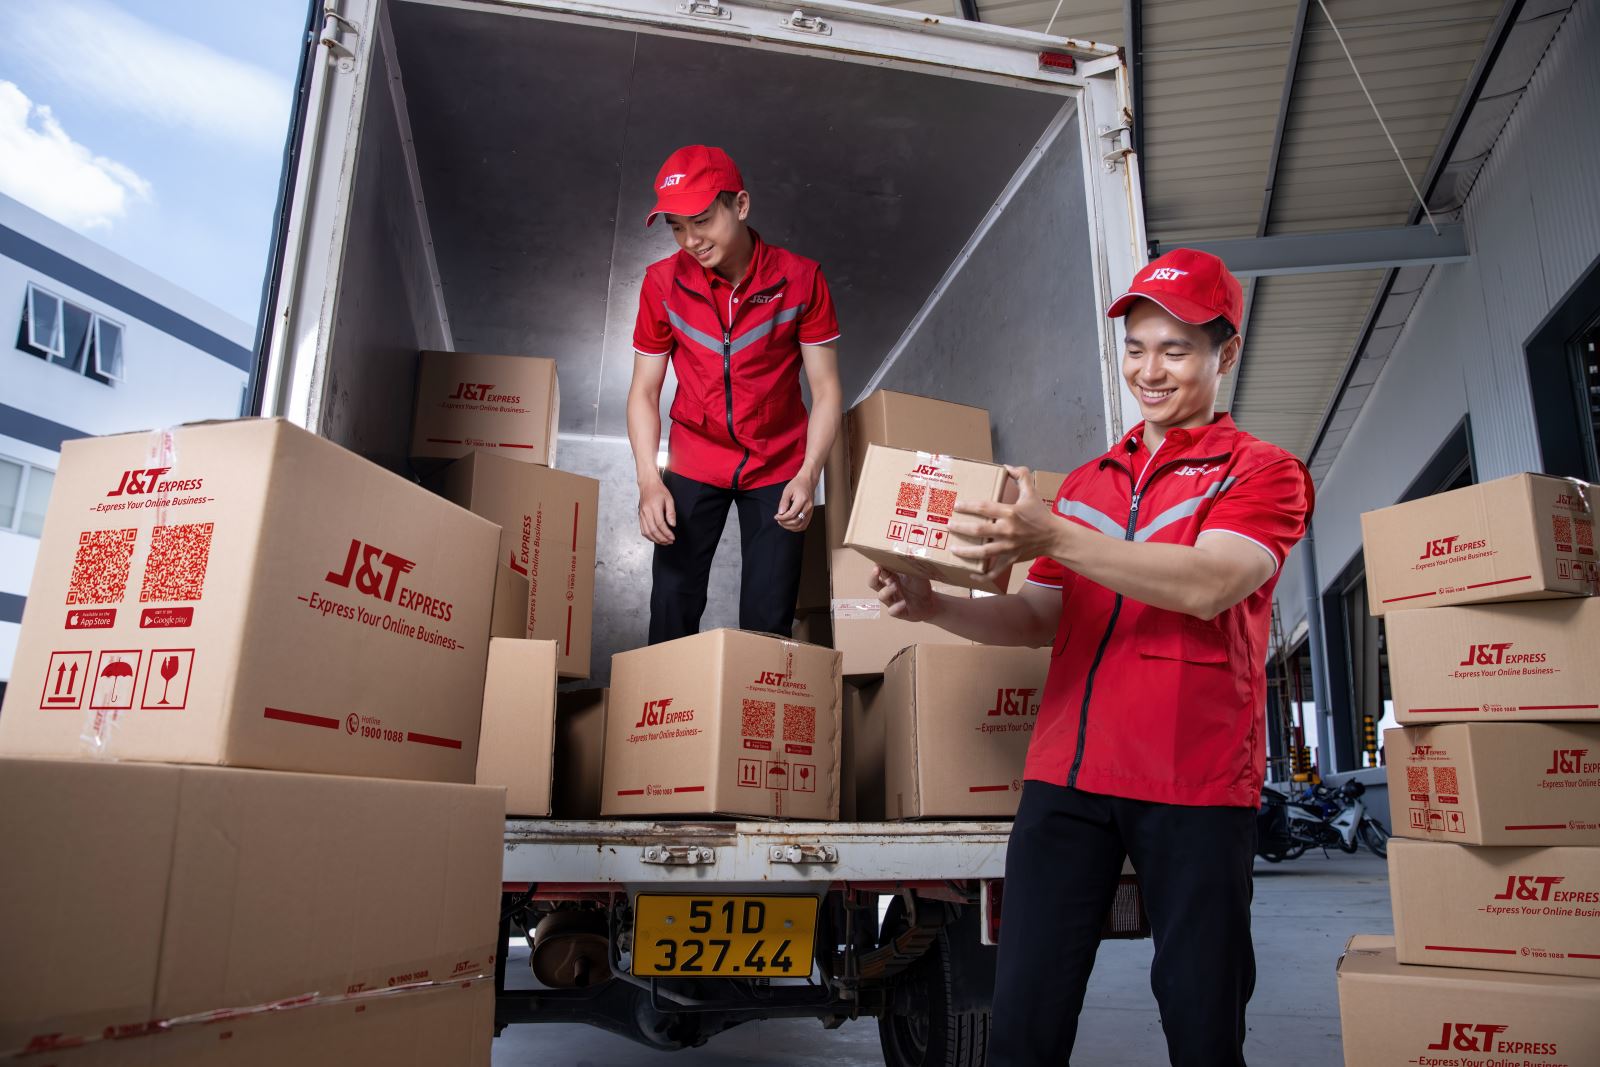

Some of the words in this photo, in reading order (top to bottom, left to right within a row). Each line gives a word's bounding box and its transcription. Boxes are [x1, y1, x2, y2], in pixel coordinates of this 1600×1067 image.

[660, 173, 686, 189] J&T
[1143, 267, 1190, 282] J&T
[448, 382, 496, 401] J&T
[488, 394, 520, 404] EXPRESS
[480, 404, 499, 412] Online
[499, 406, 525, 414] Business
[912, 464, 940, 476] J&T
[107, 467, 172, 497] J&T
[157, 478, 203, 493] EXPRESS
[96, 503, 126, 514] Express
[127, 500, 145, 510] Your
[145, 498, 170, 508] Online
[171, 496, 207, 506] Business
[520, 515, 532, 564] EXPRESS
[1420, 535, 1460, 560] J&T
[1454, 539, 1486, 553] EXPRESS
[531, 549, 540, 577] Online
[1415, 563, 1436, 571] Express
[1448, 555, 1467, 563] Online
[1467, 551, 1493, 560] Business
[325, 538, 417, 603] J&T
[398, 587, 453, 622] EXPRESS
[80, 618, 94, 626] App
[94, 617, 111, 625] Store
[153, 616, 174, 626] Google
[174, 616, 188, 625] play
[309, 591, 355, 617] Express
[357, 606, 382, 627] Your
[382, 614, 416, 638] Online
[416, 625, 457, 650] Business
[527, 598, 537, 633] Express
[1460, 643, 1514, 666] J&T
[1505, 653, 1546, 664] EXPRESS
[754, 671, 786, 686] J&T
[783, 681, 807, 690] EXPRESS
[1454, 671, 1480, 679] Express
[1498, 668, 1521, 676] Online
[1522, 666, 1554, 675] Business
[987, 688, 1038, 716] J&T
[636, 698, 673, 728] J&T
[666, 710, 694, 724] EXPRESS
[361, 726, 381, 739] 1900
[383, 729, 403, 743] 1088
[630, 734, 648, 744] Express
[659, 730, 675, 740] Online
[676, 727, 698, 738] Business
[981, 723, 1007, 734] Express
[1007, 723, 1021, 731] Your
[1023, 722, 1035, 731] Onl
[1412, 745, 1432, 755] J&T
[1546, 749, 1589, 774] J&T
[1583, 763, 1600, 773] EXPR
[1542, 780, 1564, 790] Express
[1579, 778, 1597, 787] Online
[1494, 875, 1566, 901] J&T
[1554, 891, 1600, 903] EXPRES
[689, 900, 765, 934] 51D
[1486, 905, 1520, 916] Express
[1521, 906, 1540, 915] Your
[1543, 907, 1573, 916] Online
[1575, 908, 1600, 917] Busin
[654, 939, 793, 972] 327.44
[453, 960, 470, 973] J&T
[1427, 1022, 1509, 1053] J&T
[1498, 1041, 1557, 1055] EXPRESS
[1419, 1056, 1459, 1067] Express
[1461, 1058, 1485, 1067] Your
